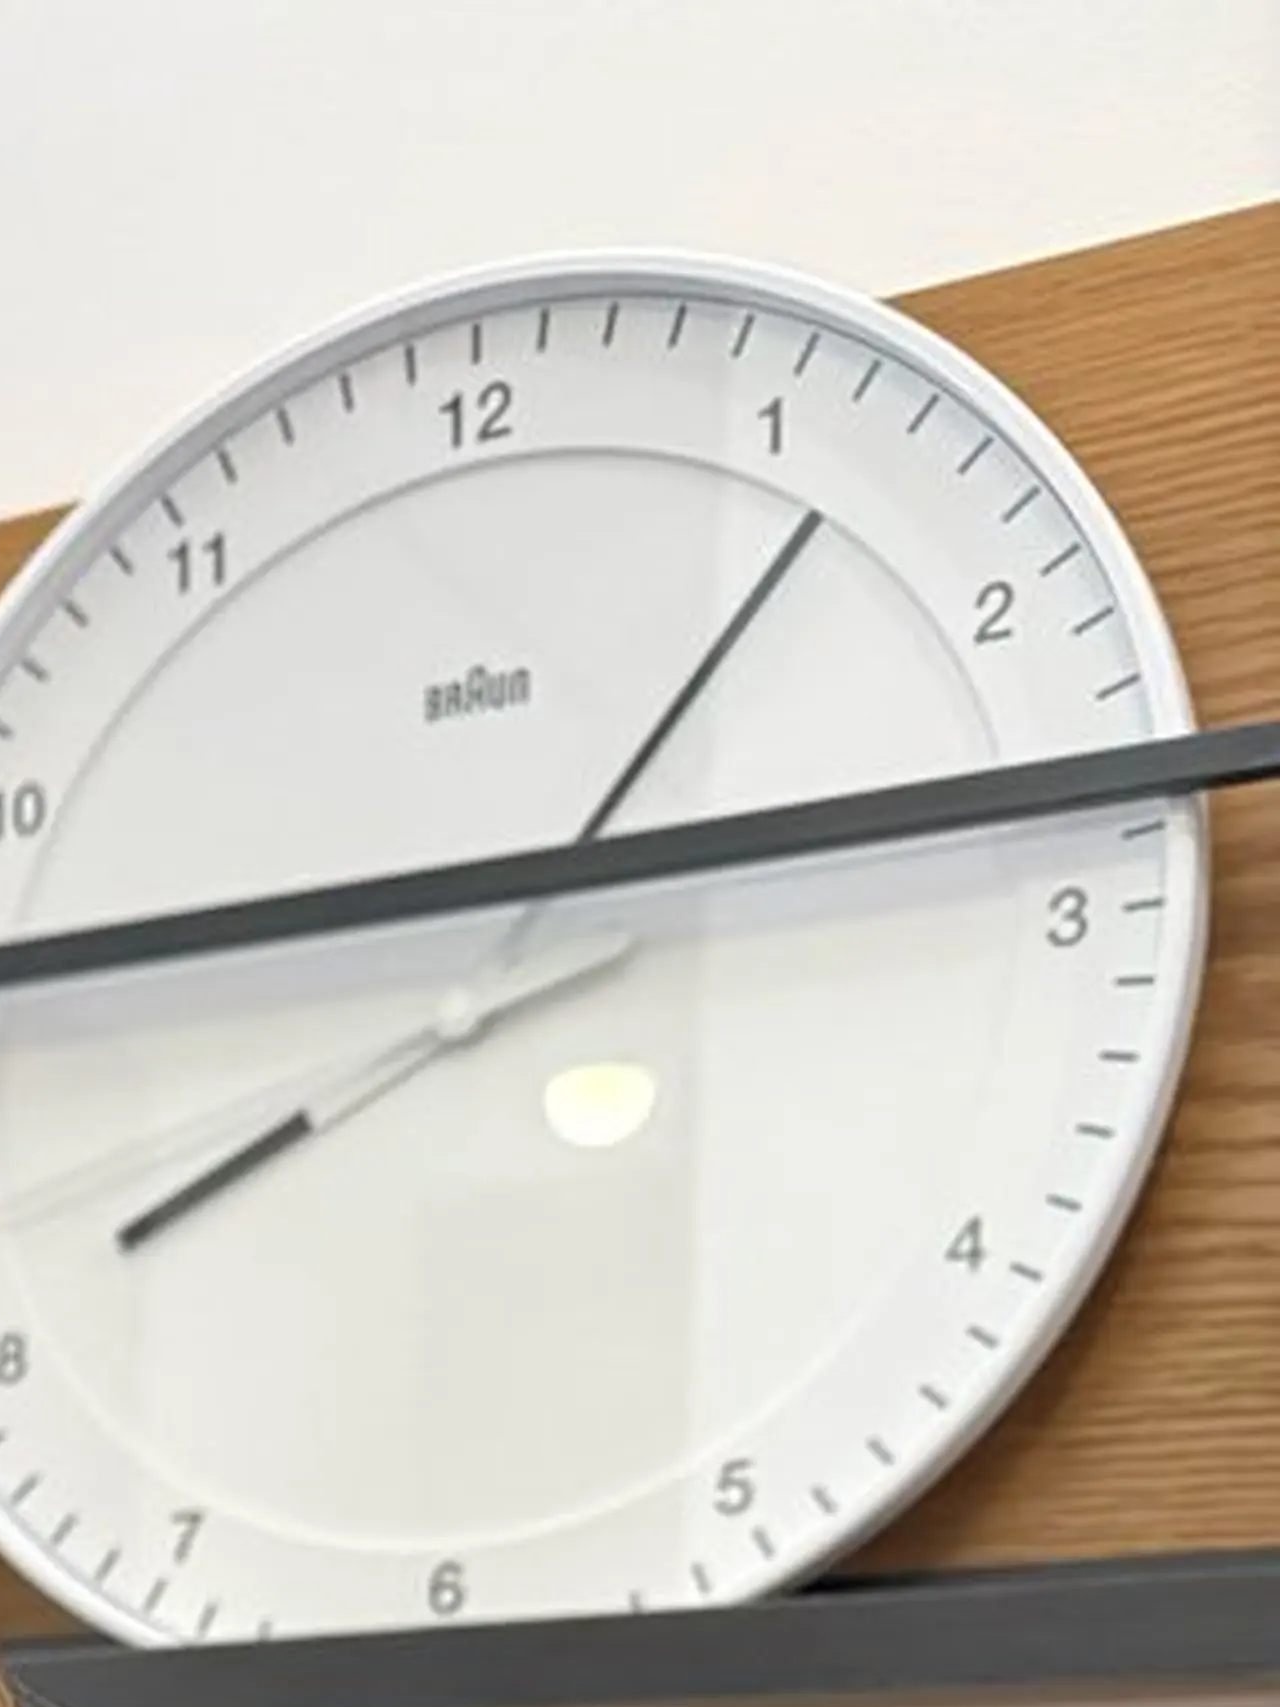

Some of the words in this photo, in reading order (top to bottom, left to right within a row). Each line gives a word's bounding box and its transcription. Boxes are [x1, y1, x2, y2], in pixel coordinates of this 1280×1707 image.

[438, 381, 516, 450] 12
[758, 398, 787, 453] 1
[167, 533, 229, 597] 11
[971, 579, 1018, 644] 2
[1047, 888, 1090, 947] 3
[944, 1216, 987, 1272] 4
[713, 1459, 756, 1515] 5
[167, 1510, 207, 1562] 7
[427, 1562, 465, 1615] 6
